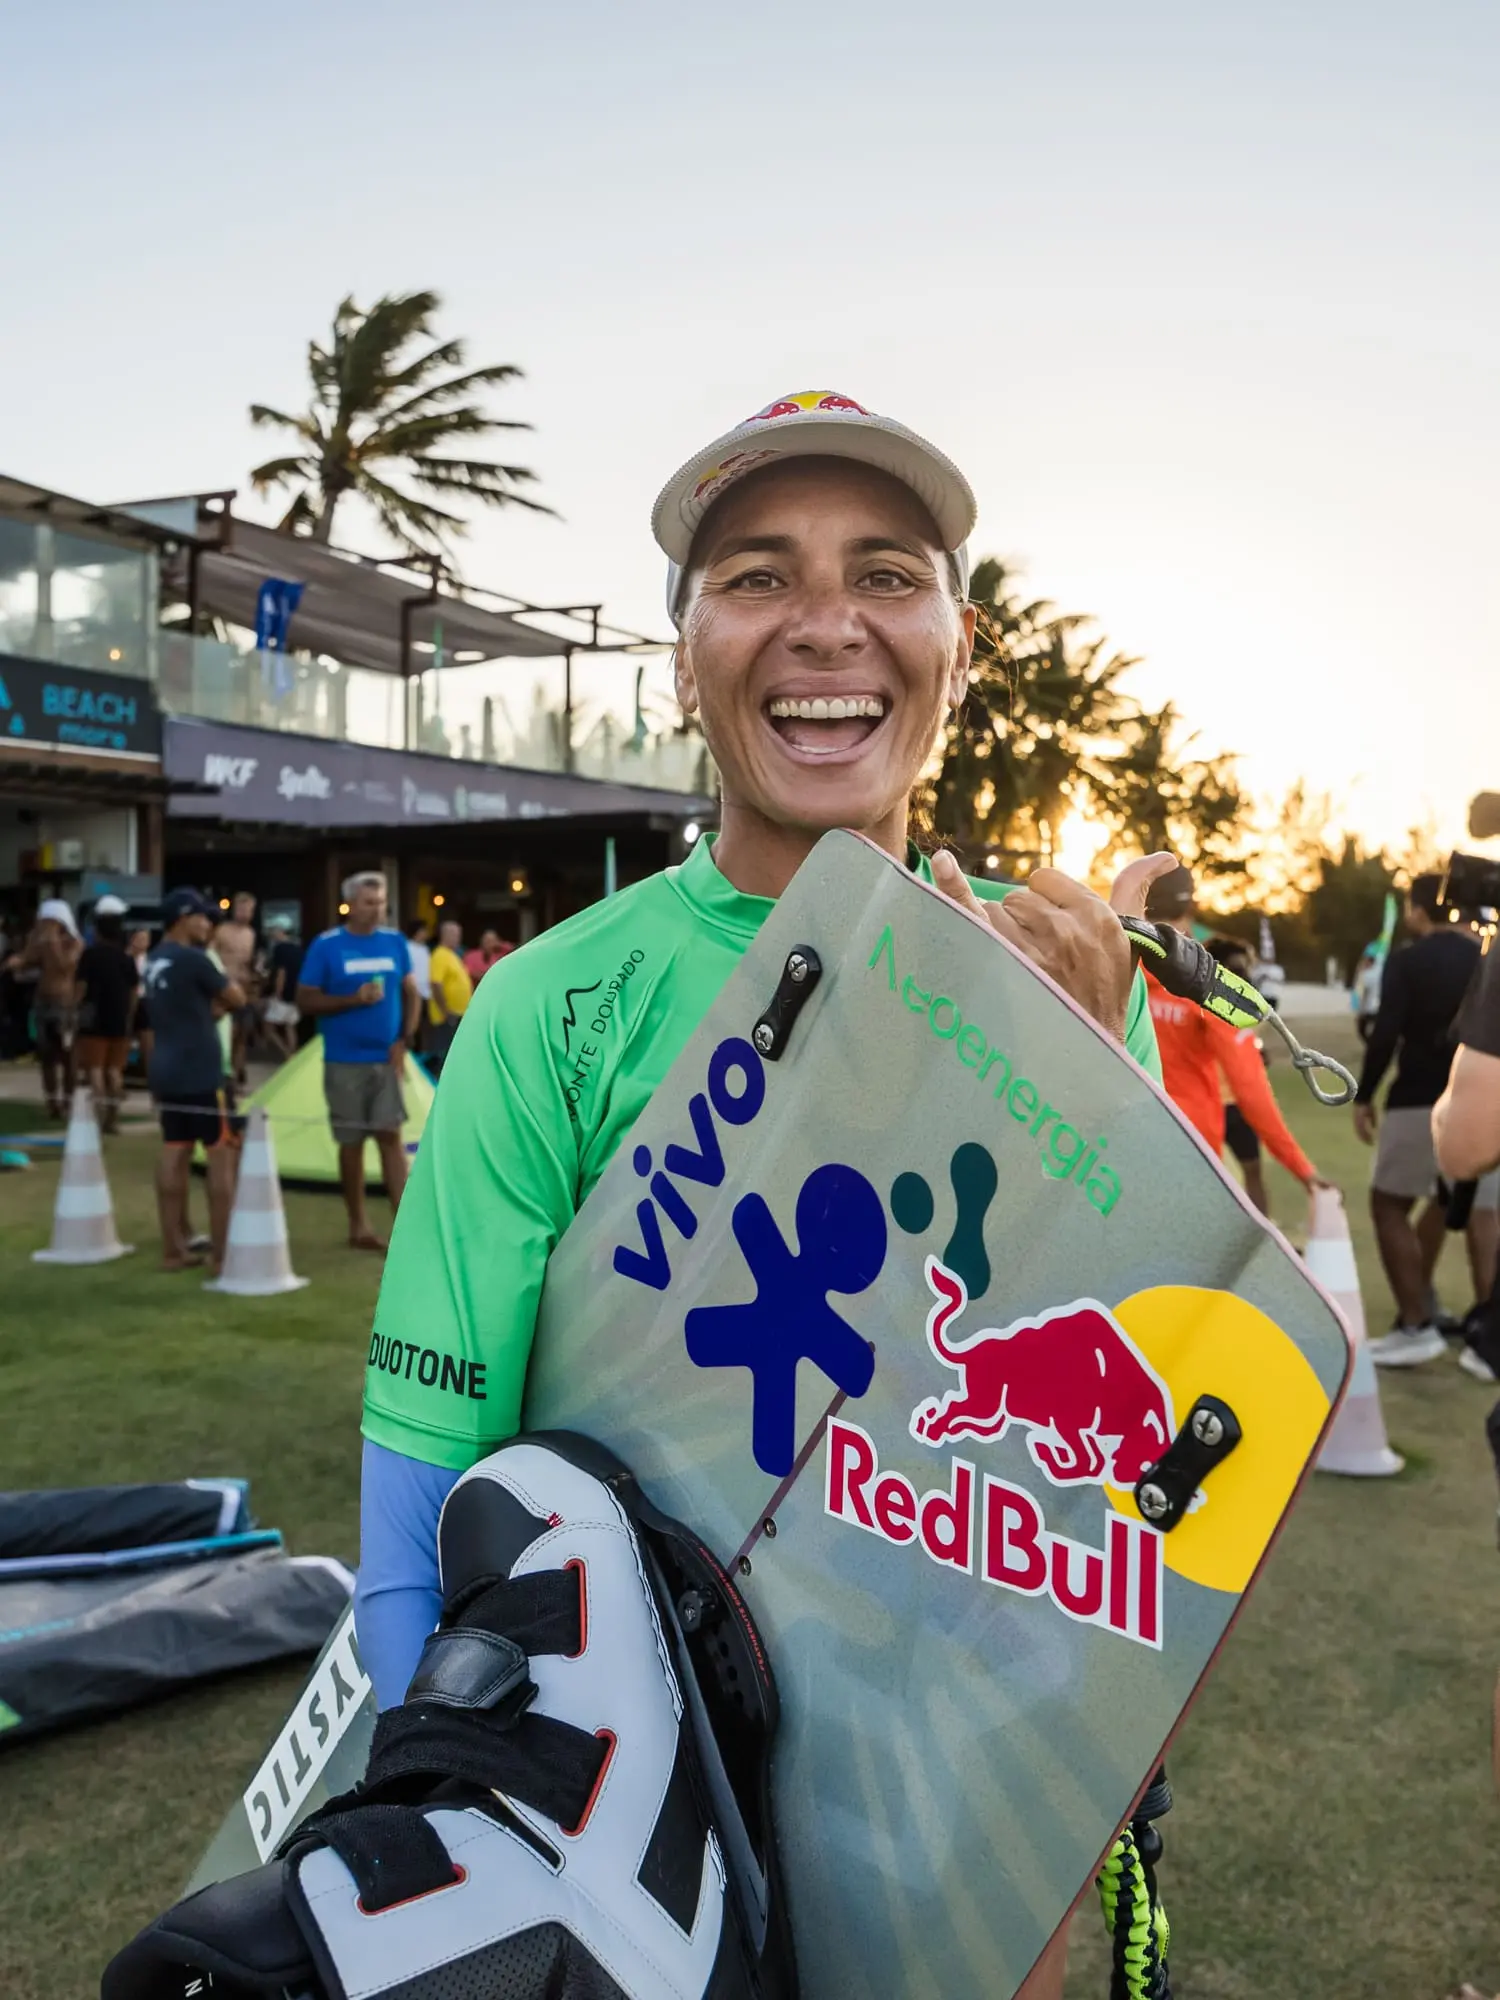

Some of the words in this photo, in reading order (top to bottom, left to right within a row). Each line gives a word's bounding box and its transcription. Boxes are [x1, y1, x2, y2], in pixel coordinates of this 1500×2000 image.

[42, 683, 137, 726] BEACH
[591, 949, 645, 1035] DOURADO
[613, 1037, 766, 1291] vivo
[368, 1332, 487, 1400] DUOTONE
[827, 1419, 973, 1571] Red
[985, 1481, 1160, 1645] Bull
